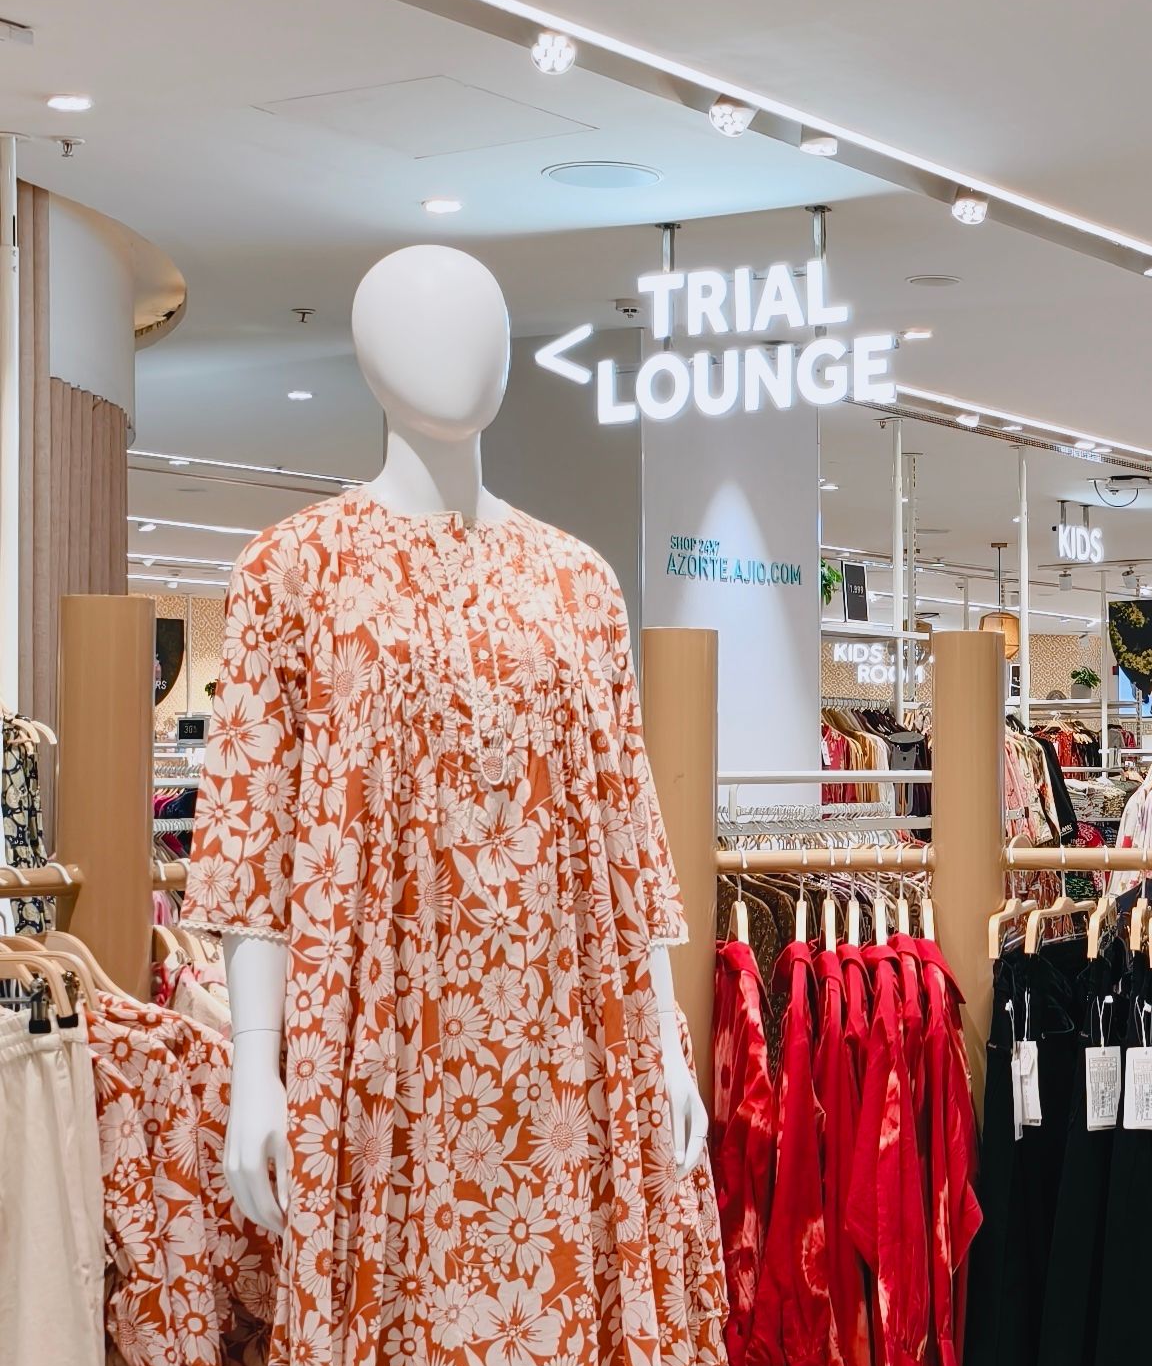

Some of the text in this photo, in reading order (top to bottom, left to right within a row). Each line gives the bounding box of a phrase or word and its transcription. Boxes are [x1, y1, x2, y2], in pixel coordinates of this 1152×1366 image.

[637, 258, 849, 340] TRIAL
[597, 332, 897, 426] LOUNGE
[670, 534, 697, 552] SHOP
[1058, 524, 1104, 564] KIDS
[666, 552, 802, 587] AZORTE.AJIO.COM
[833, 643, 884, 663] KIDS
